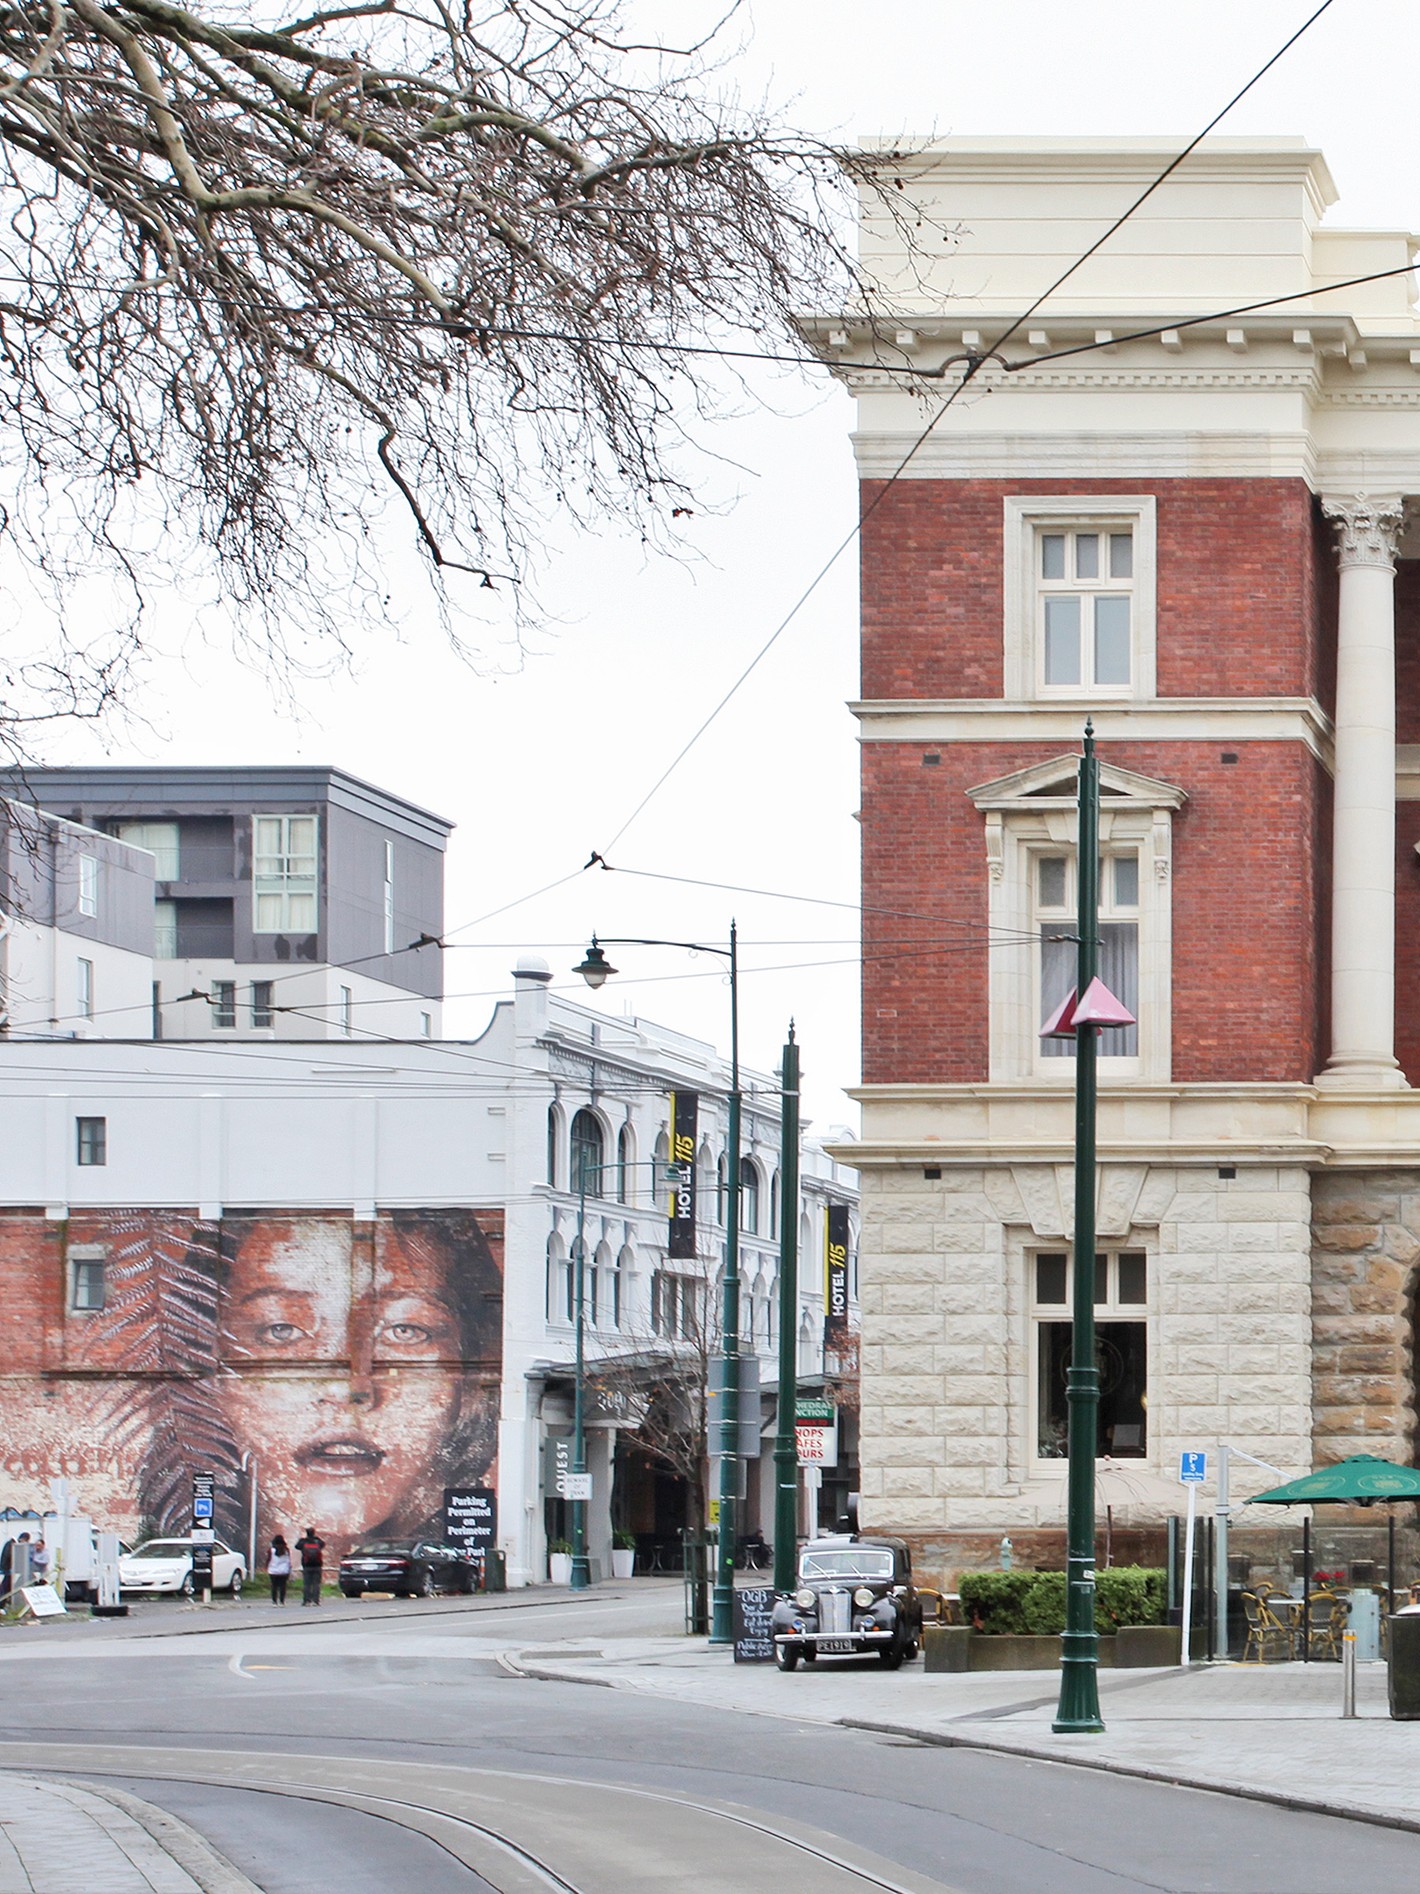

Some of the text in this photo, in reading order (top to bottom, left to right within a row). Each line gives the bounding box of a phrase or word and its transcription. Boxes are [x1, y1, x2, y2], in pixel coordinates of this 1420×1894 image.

[674, 1132, 694, 1219] HOTEL 115
[829, 1241, 846, 1317] HOTEL 115
[794, 1428, 824, 1438] HOPS
[796, 1438, 823, 1448] AFES
[1188, 1453, 1198, 1464] P
[555, 1441, 568, 1493] QUEST
[452, 1496, 487, 1507] Parking
[447, 1507, 491, 1517] Permitted
[463, 1518, 476, 1526] on
[447, 1526, 491, 1536] Perimeter
[463, 1537, 475, 1546] of
[741, 1589, 768, 1603] OGB
